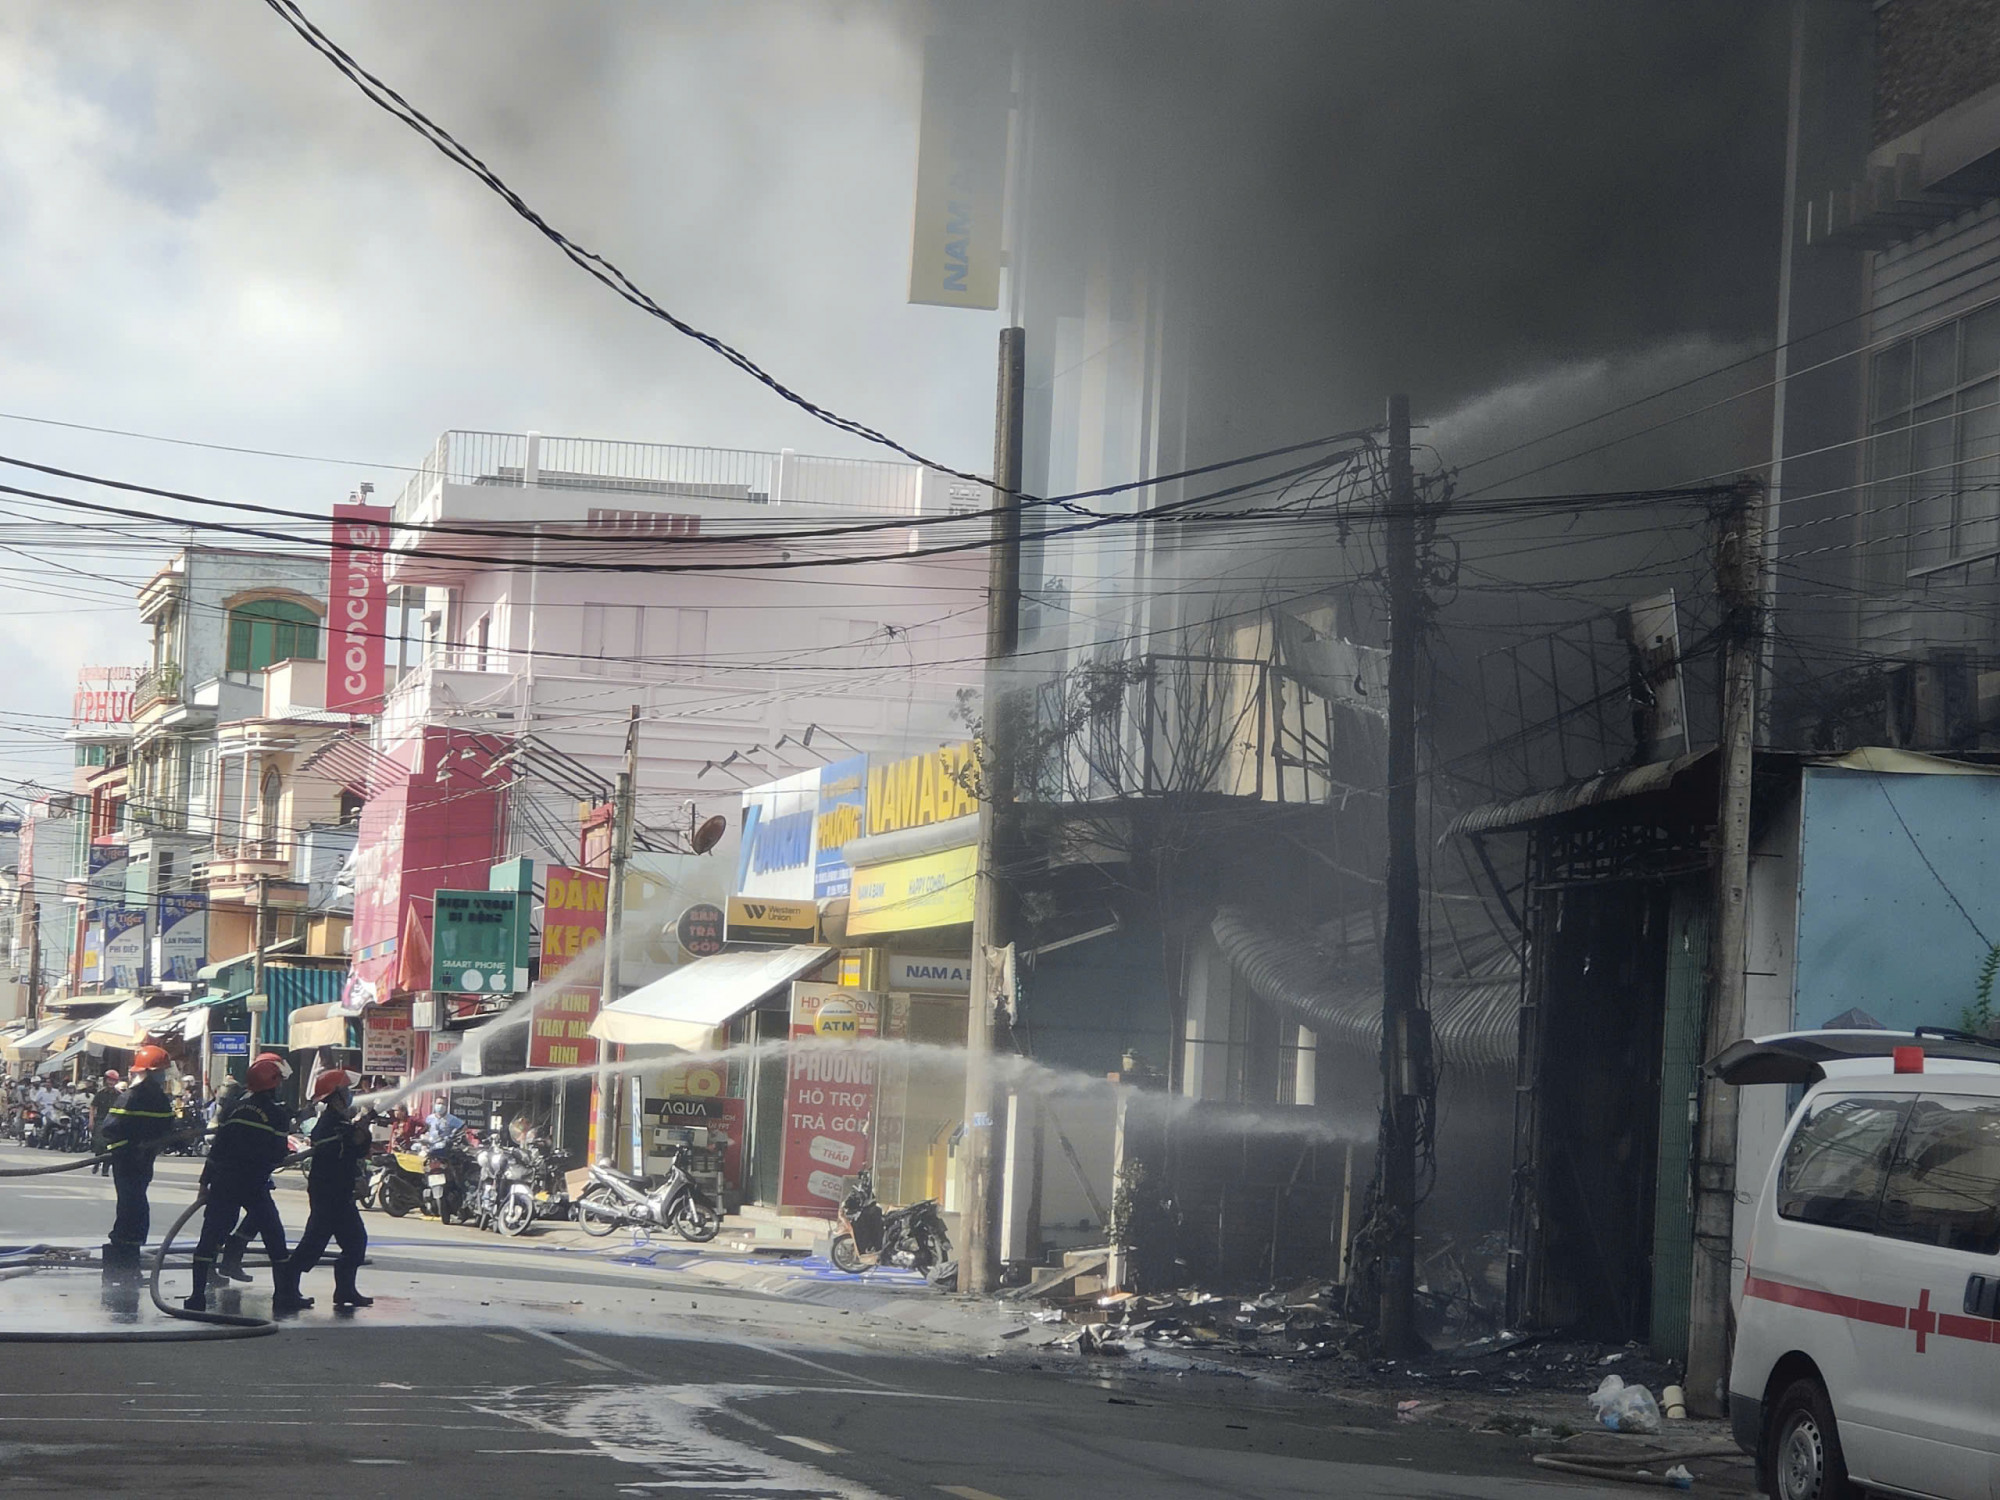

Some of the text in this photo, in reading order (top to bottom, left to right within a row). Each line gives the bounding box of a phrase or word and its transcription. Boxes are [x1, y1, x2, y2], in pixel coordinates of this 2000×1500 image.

[943, 200, 972, 292] NAM
[547, 871, 606, 912] DÁN
[176, 899, 204, 912] Tiger
[769, 905, 801, 915] Western
[117, 913, 144, 927] Tiger
[768, 914, 792, 922] Union
[442, 960, 506, 970] SMART PHONE
[906, 964, 948, 979] NAM
[951, 967, 963, 981] A
[801, 996, 820, 1009] HD
[536, 1018, 566, 1037] THAY
[821, 1020, 855, 1032] ATM
[549, 1043, 579, 1065] HÌNH
[661, 1101, 706, 1116] AQUA
[829, 1091, 868, 1111] TRỢ
[791, 1112, 826, 1130] TRẢ
[823, 1148, 850, 1163] THẤP
[821, 1179, 843, 1191] CCC
